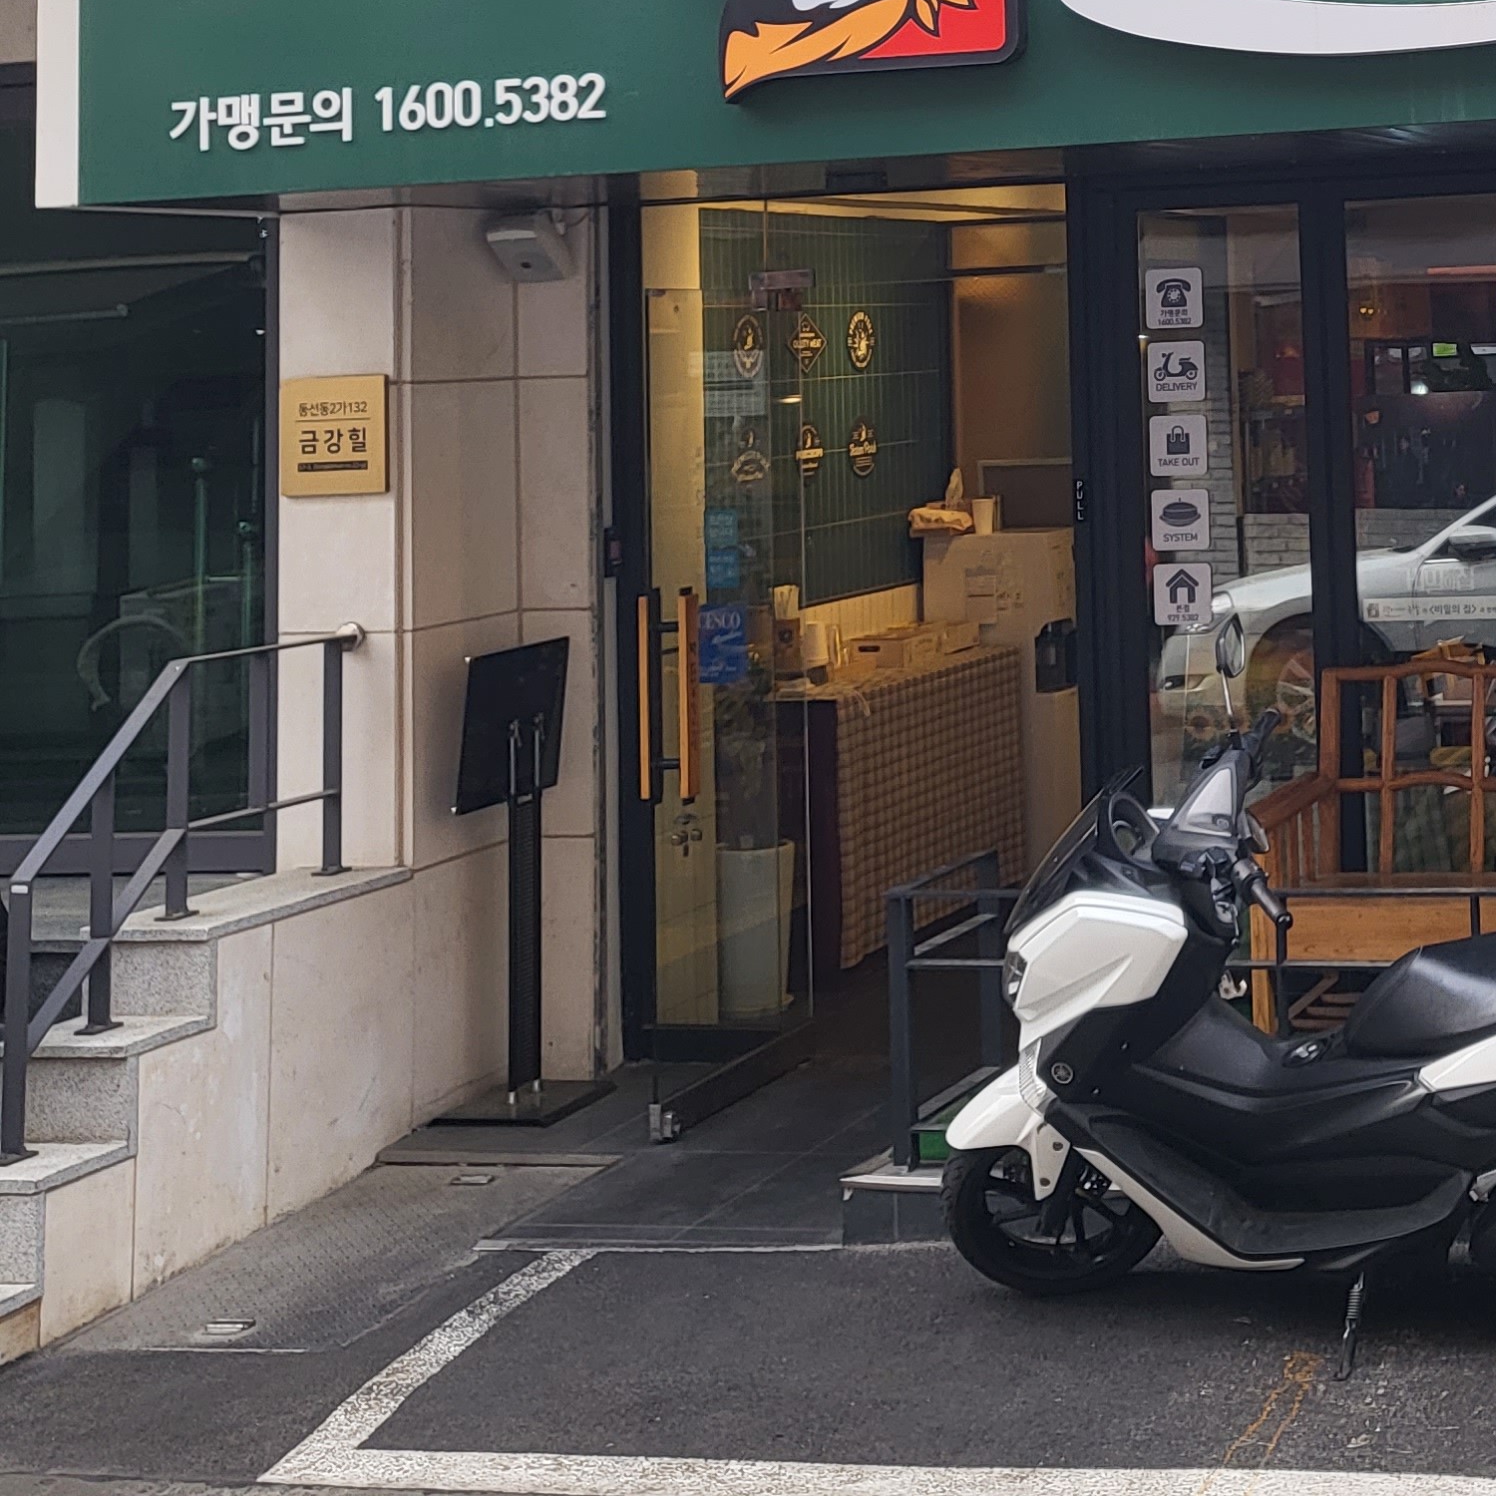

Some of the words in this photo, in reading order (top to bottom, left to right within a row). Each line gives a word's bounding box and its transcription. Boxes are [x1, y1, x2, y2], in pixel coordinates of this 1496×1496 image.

[169, 86, 353, 152] 가맹문의
[373, 72, 608, 131] 1600.5382
[1155, 382, 1198, 392] DELIVERY
[299, 427, 367, 455] 금강힐
[1157, 458, 1180, 467] TAKE
[1182, 457, 1200, 466] OUT
[1163, 533, 1198, 543] SYSTEM
